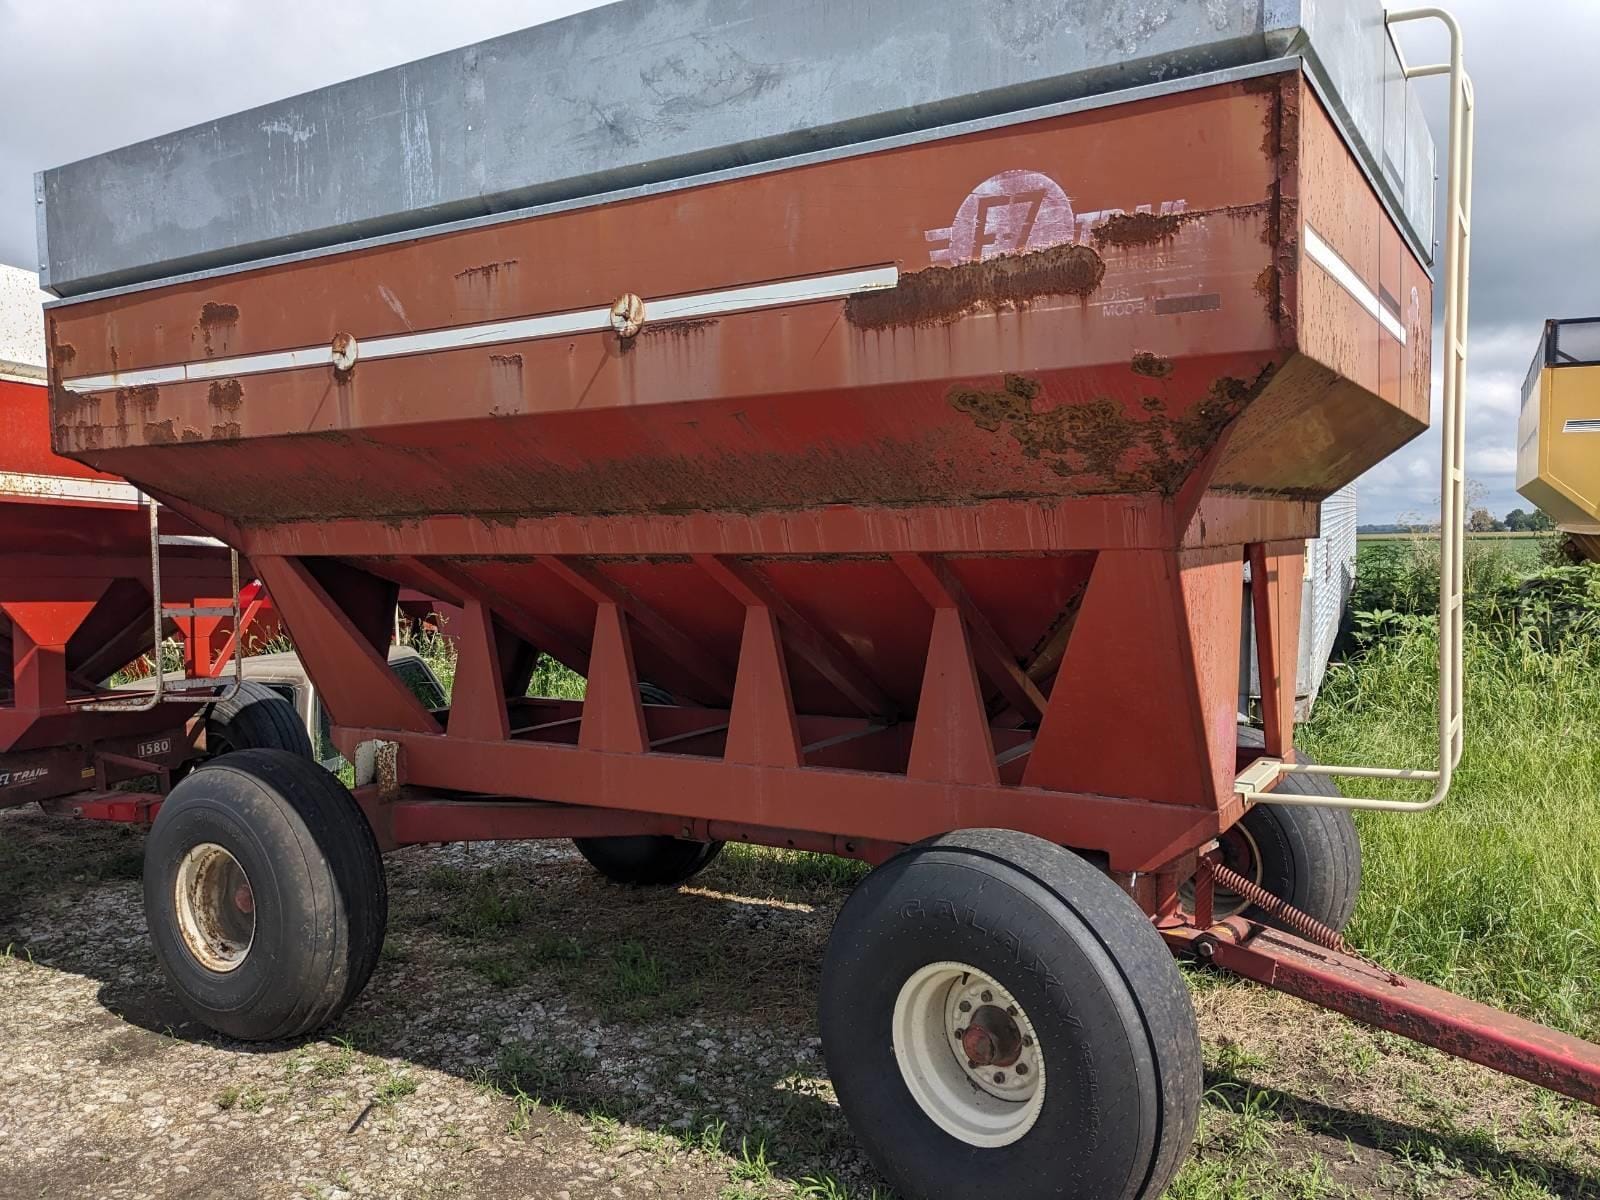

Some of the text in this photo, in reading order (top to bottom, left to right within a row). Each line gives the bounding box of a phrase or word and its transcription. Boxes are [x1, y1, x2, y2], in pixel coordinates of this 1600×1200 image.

[140, 742, 169, 756] 1580
[13, 767, 48, 781] TRAIL
[899, 898, 1084, 1030] GALAXY
